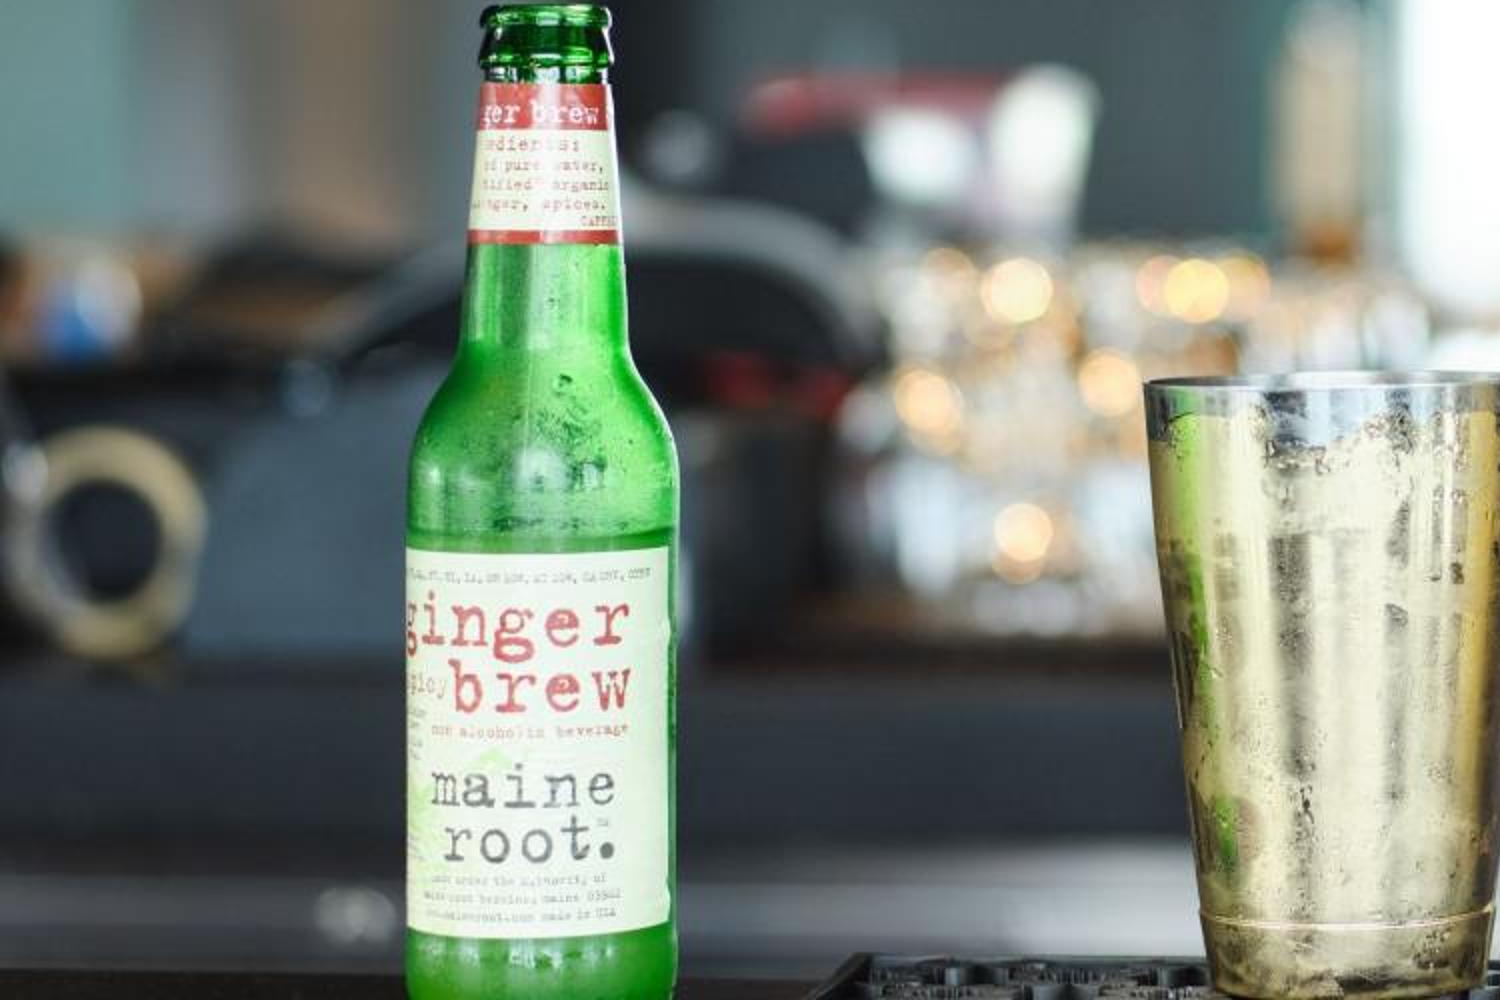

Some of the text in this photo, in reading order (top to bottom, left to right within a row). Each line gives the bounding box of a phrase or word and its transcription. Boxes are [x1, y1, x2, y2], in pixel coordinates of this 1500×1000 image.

[530, 99, 600, 125] brew
[406, 588, 631, 662] ginger
[448, 658, 632, 714] brew
[430, 762, 616, 808] maine
[443, 813, 617, 865] root.
